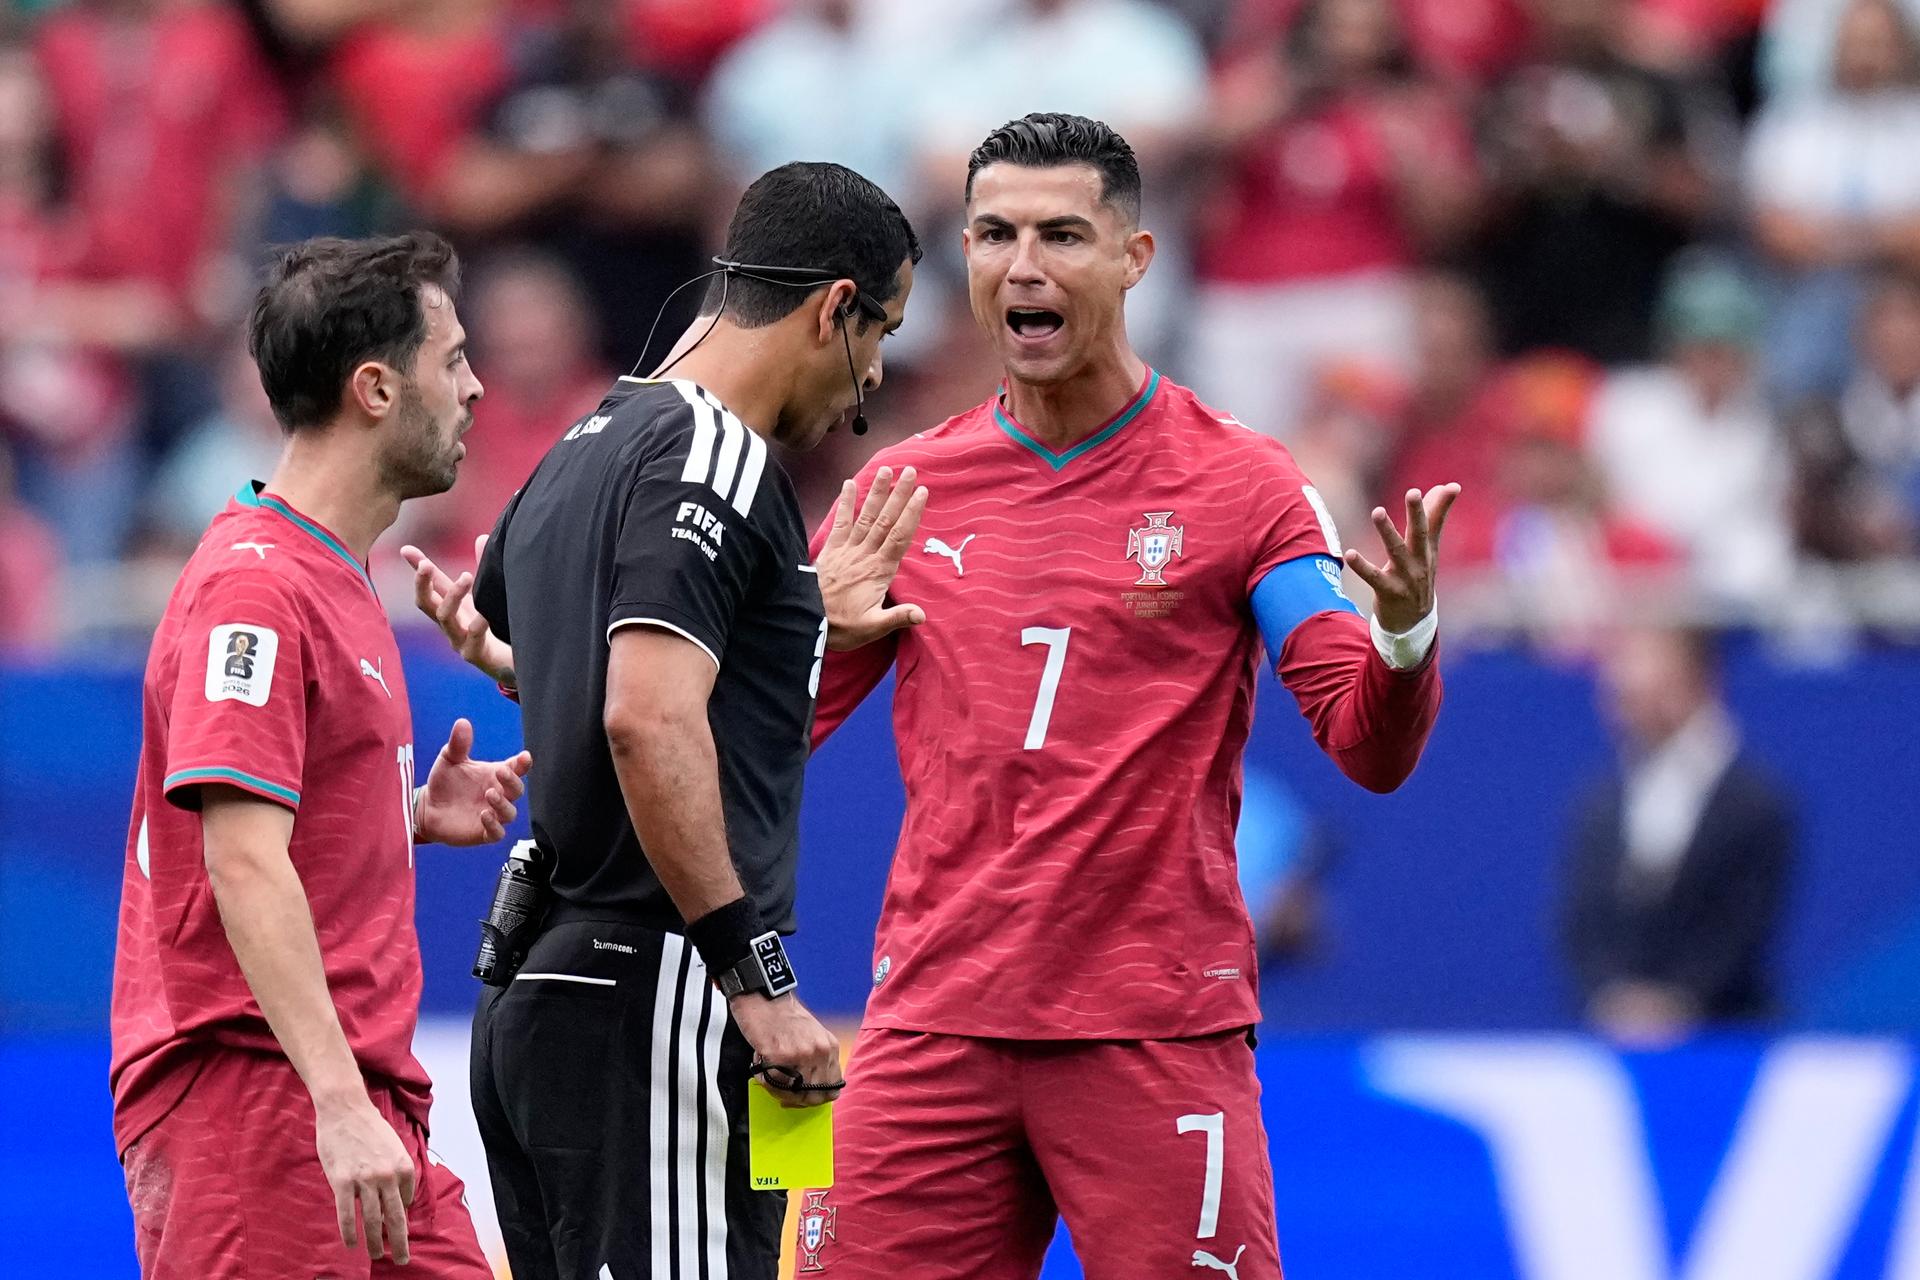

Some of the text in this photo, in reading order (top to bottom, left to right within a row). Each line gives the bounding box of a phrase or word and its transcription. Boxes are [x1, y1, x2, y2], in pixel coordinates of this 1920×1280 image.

[671, 527, 718, 562] TEAM ONE
[676, 501, 724, 547] FIFA
[1020, 626, 1072, 750] 7
[755, 1176, 780, 1186] FIFA
[1176, 1111, 1225, 1239] 7
